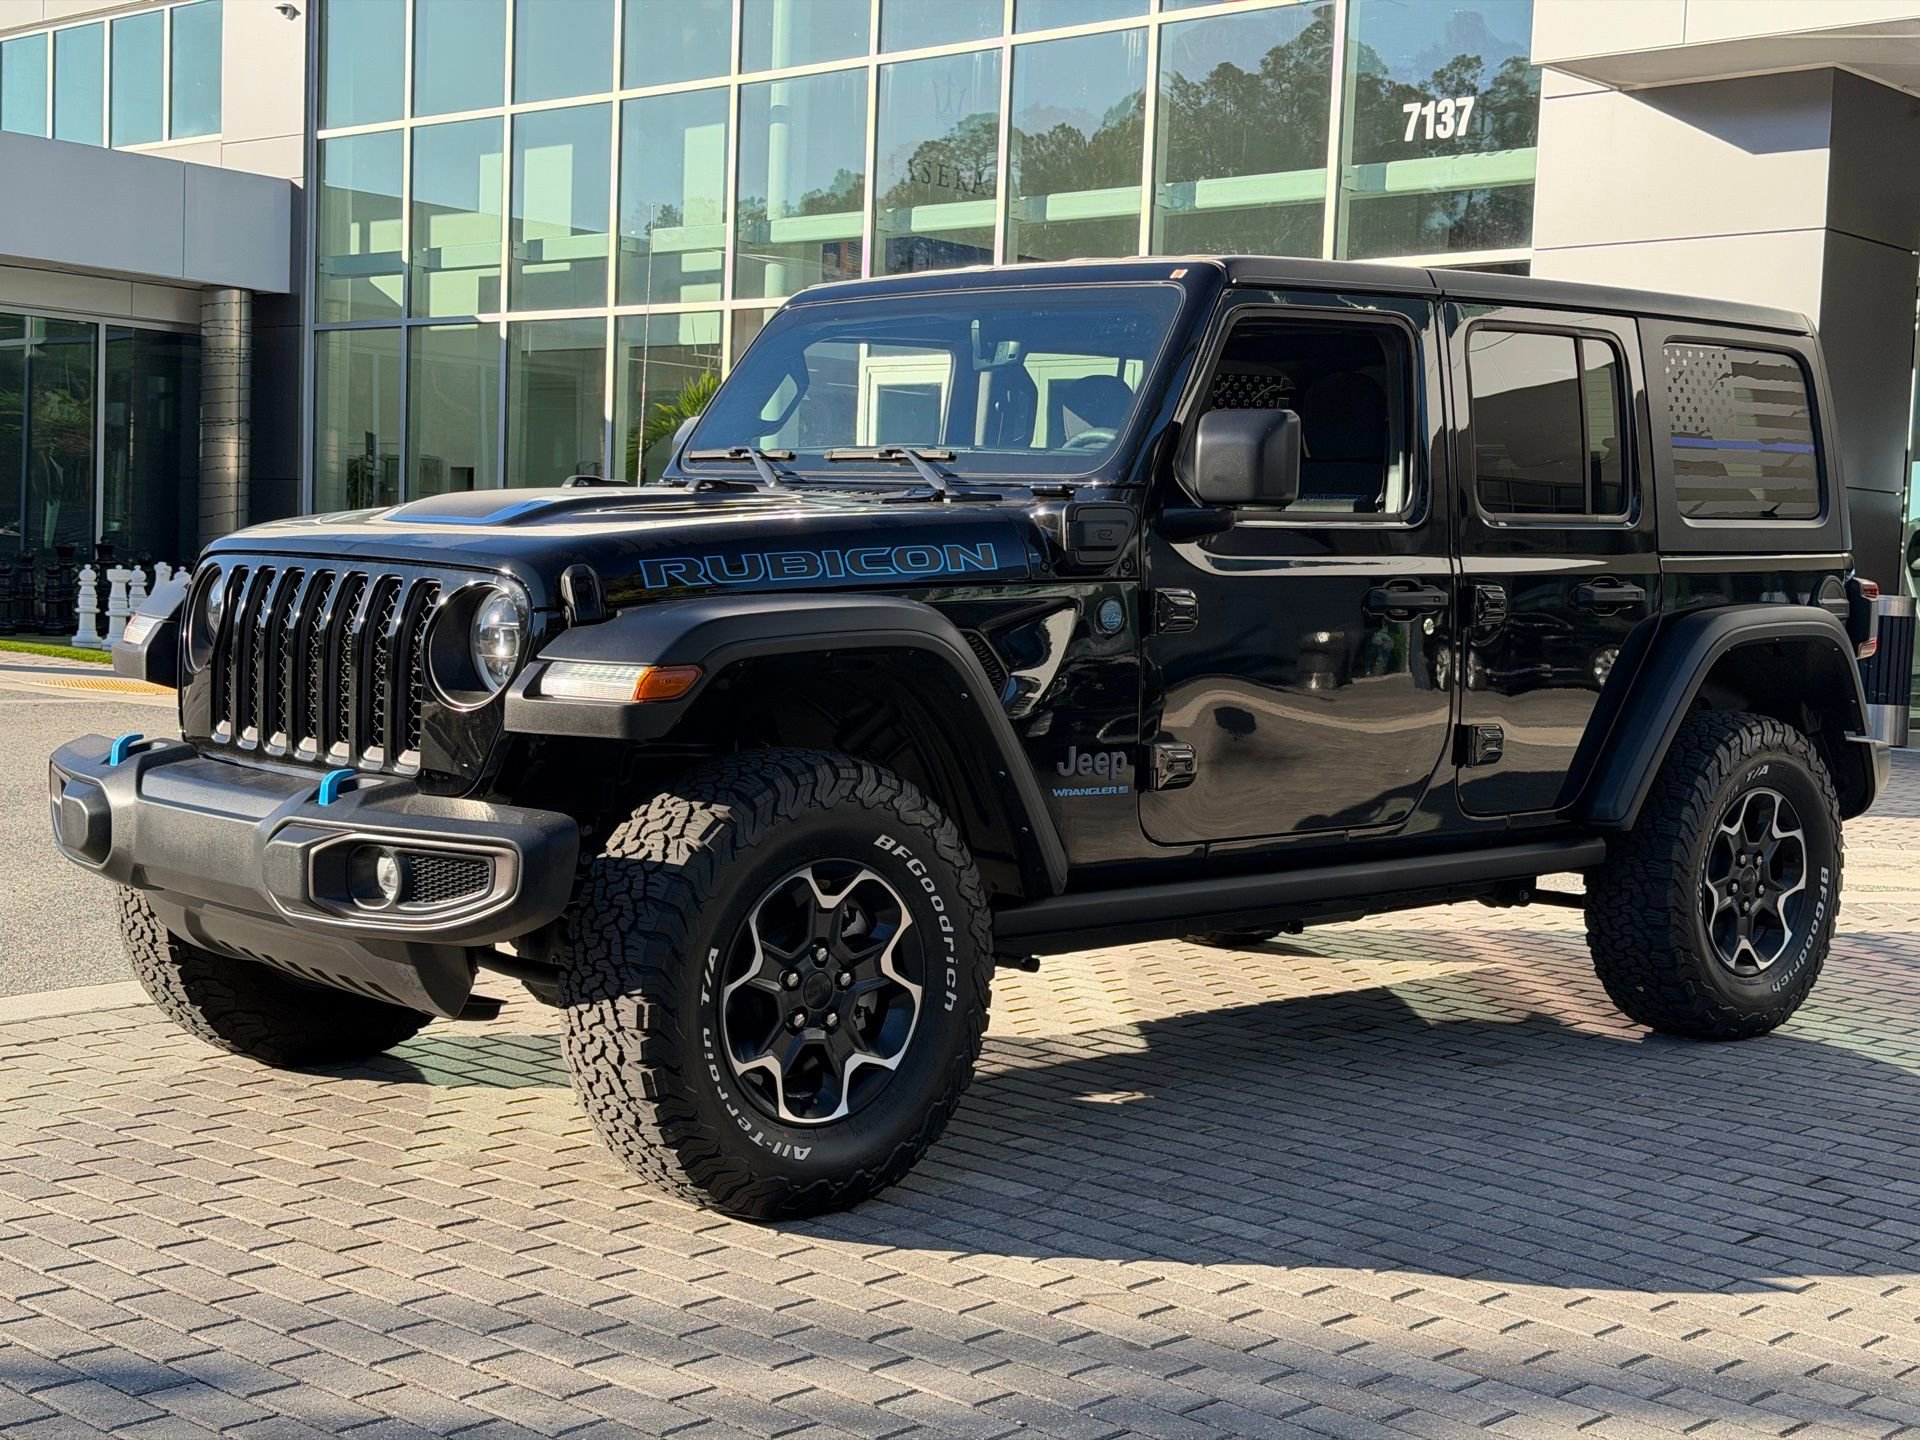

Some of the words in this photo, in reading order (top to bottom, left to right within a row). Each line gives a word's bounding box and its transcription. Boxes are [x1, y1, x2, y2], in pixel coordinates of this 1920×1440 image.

[1402, 96, 1475, 142] 7137
[639, 543, 1000, 588] RUBICON
[1057, 745, 1127, 781] Jeep
[1745, 765, 1769, 783] T/A
[1052, 786, 1117, 797] WRANGLER
[873, 834, 958, 1012] BFGoodrich
[1772, 866, 1829, 992] BFGoodrich
[700, 948, 719, 1006] T/A
